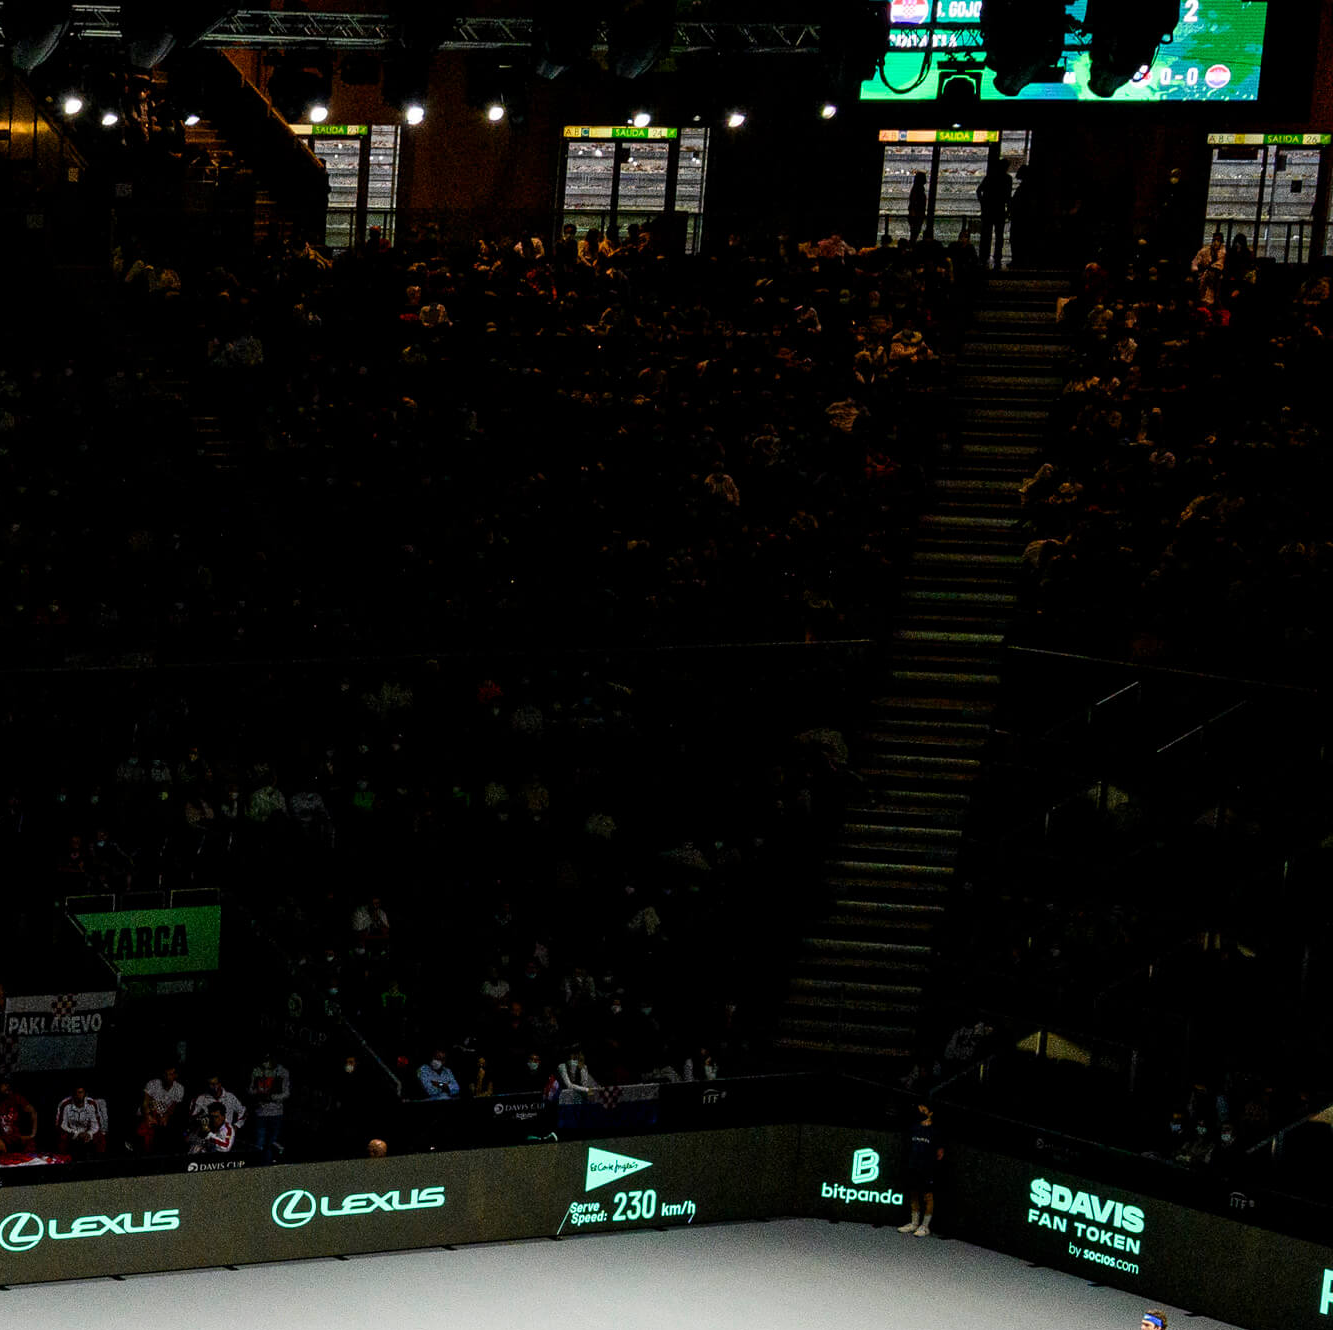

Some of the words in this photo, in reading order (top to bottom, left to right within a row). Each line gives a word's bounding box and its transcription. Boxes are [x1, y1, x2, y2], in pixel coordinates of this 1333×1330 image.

[1183, 0, 1198, 22] 2
[316, 126, 344, 135] SALIDA
[615, 128, 645, 138] SALIDA
[939, 131, 970, 140] SALIDA
[1267, 134, 1299, 143] SALIDA
[504, 1102, 528, 1112] DAVIS
[200, 1162, 227, 1172] DAVIS
[228, 1160, 245, 1169] CUP
[321, 1186, 445, 1216] LEXUS
[821, 1182, 904, 1206] bitpanda
[1030, 1177, 1145, 1233] $DAVIS
[570, 1202, 601, 1213] Serve
[612, 1190, 657, 1222] 230
[661, 1200, 696, 1217] km/h
[48, 1209, 180, 1240] LEXUS
[571, 1212, 608, 1225] Speed:
[1028, 1209, 1067, 1233] FAN
[1073, 1222, 1140, 1255] TOKEN
[1068, 1241, 1081, 1259] by
[1083, 1248, 1139, 1275] socios.com
